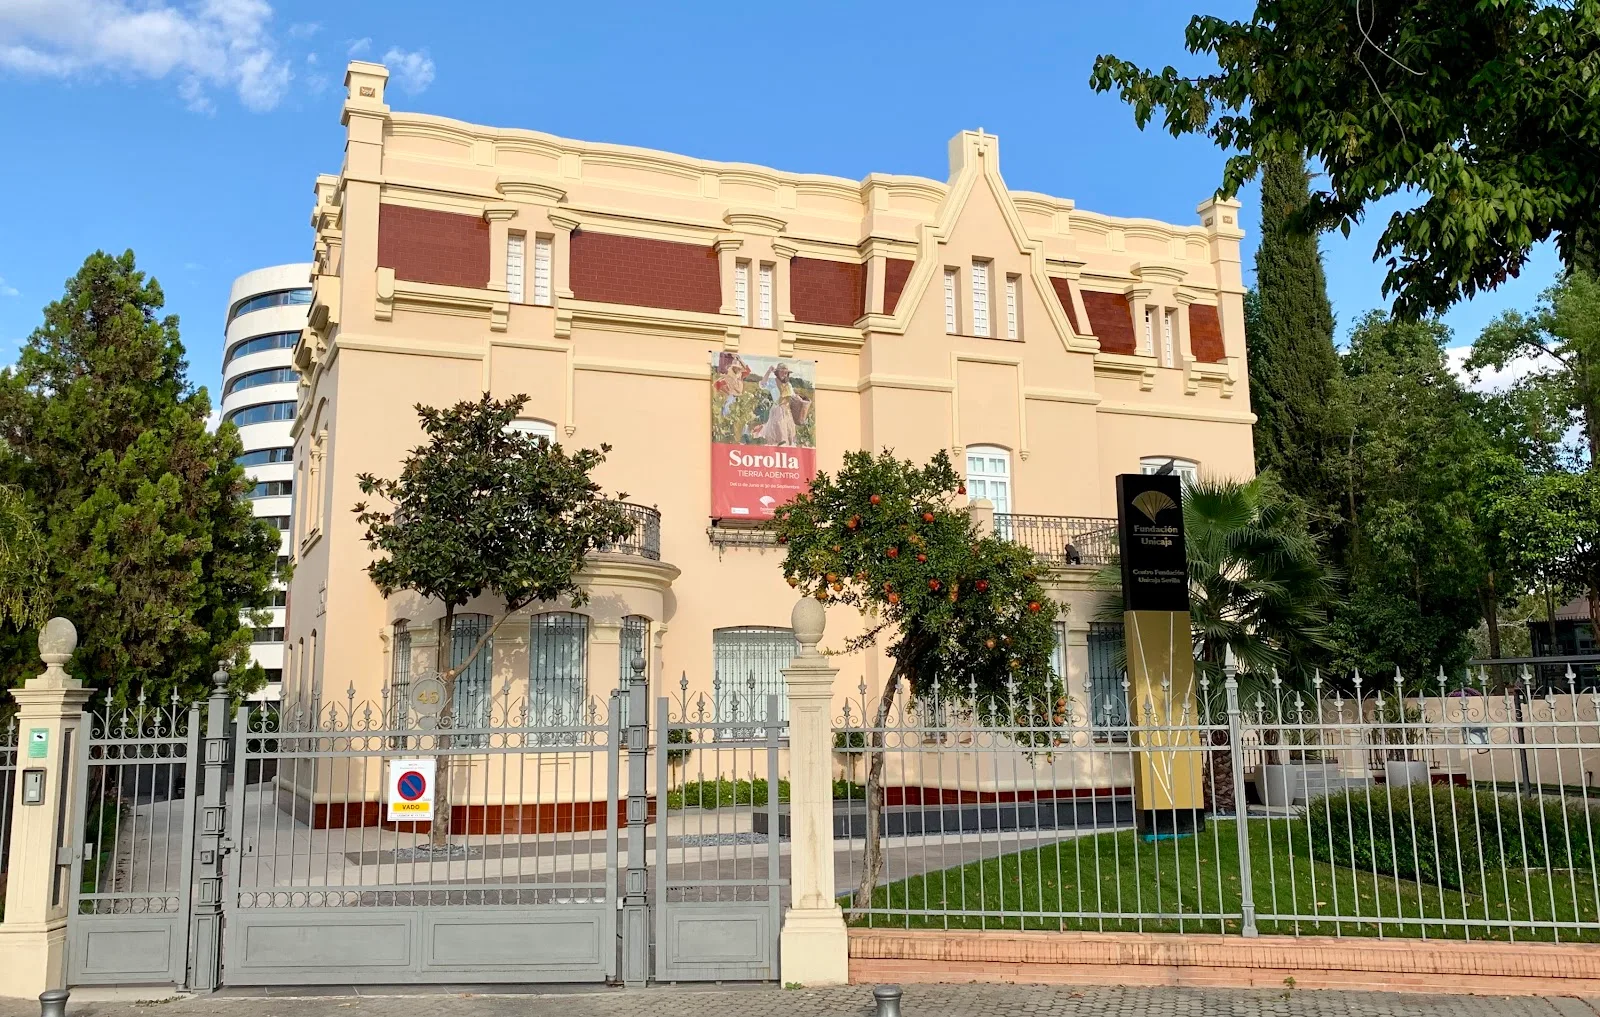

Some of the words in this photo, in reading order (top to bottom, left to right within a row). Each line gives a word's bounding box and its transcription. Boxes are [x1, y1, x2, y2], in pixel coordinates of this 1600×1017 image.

[729, 449, 799, 469] Sorolla
[737, 469, 763, 478] TIERRA
[764, 471, 800, 480] ADENTRO
[1133, 524, 1178, 533] Fundación
[1140, 536, 1173, 547] Unicaja
[417, 689, 440, 705] 45
